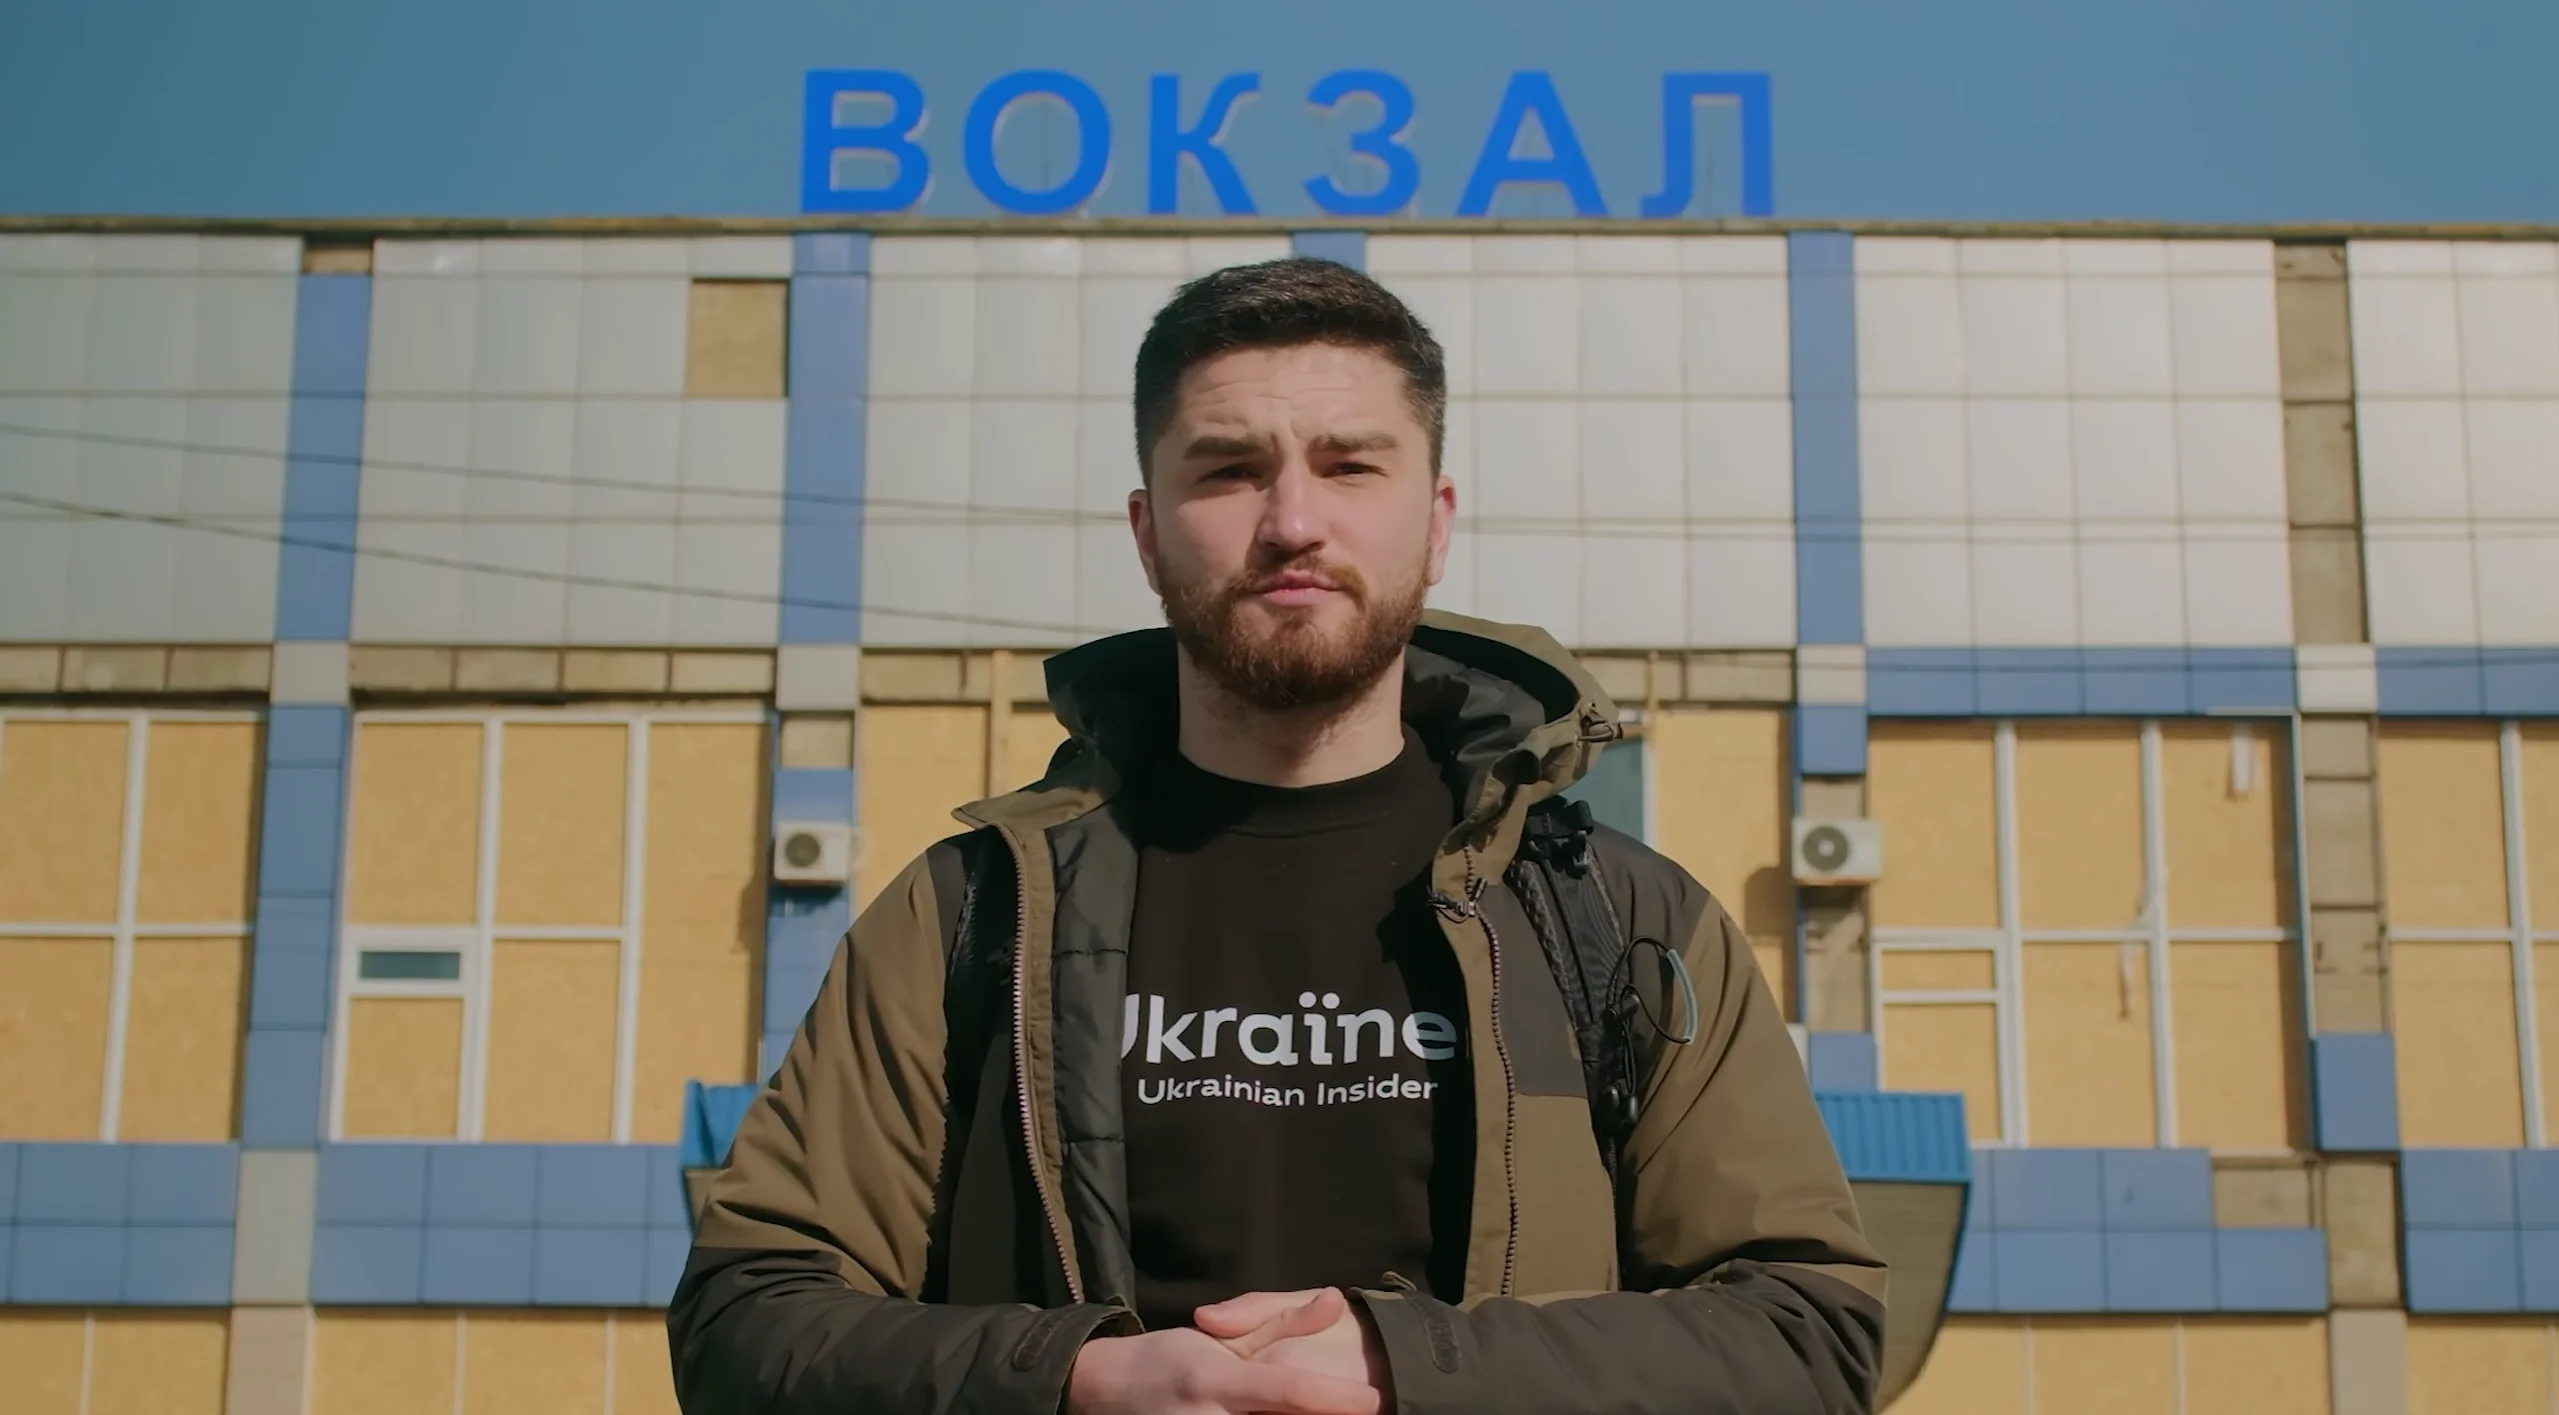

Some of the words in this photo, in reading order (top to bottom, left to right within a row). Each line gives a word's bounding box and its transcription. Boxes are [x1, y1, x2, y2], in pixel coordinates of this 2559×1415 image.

[800, 68, 1775, 217] ВОКЗАЛ
[1121, 991, 1470, 1066] kraïne
[1137, 1073, 1306, 1107] Ukrainian
[1316, 1072, 1438, 1106] Insider
